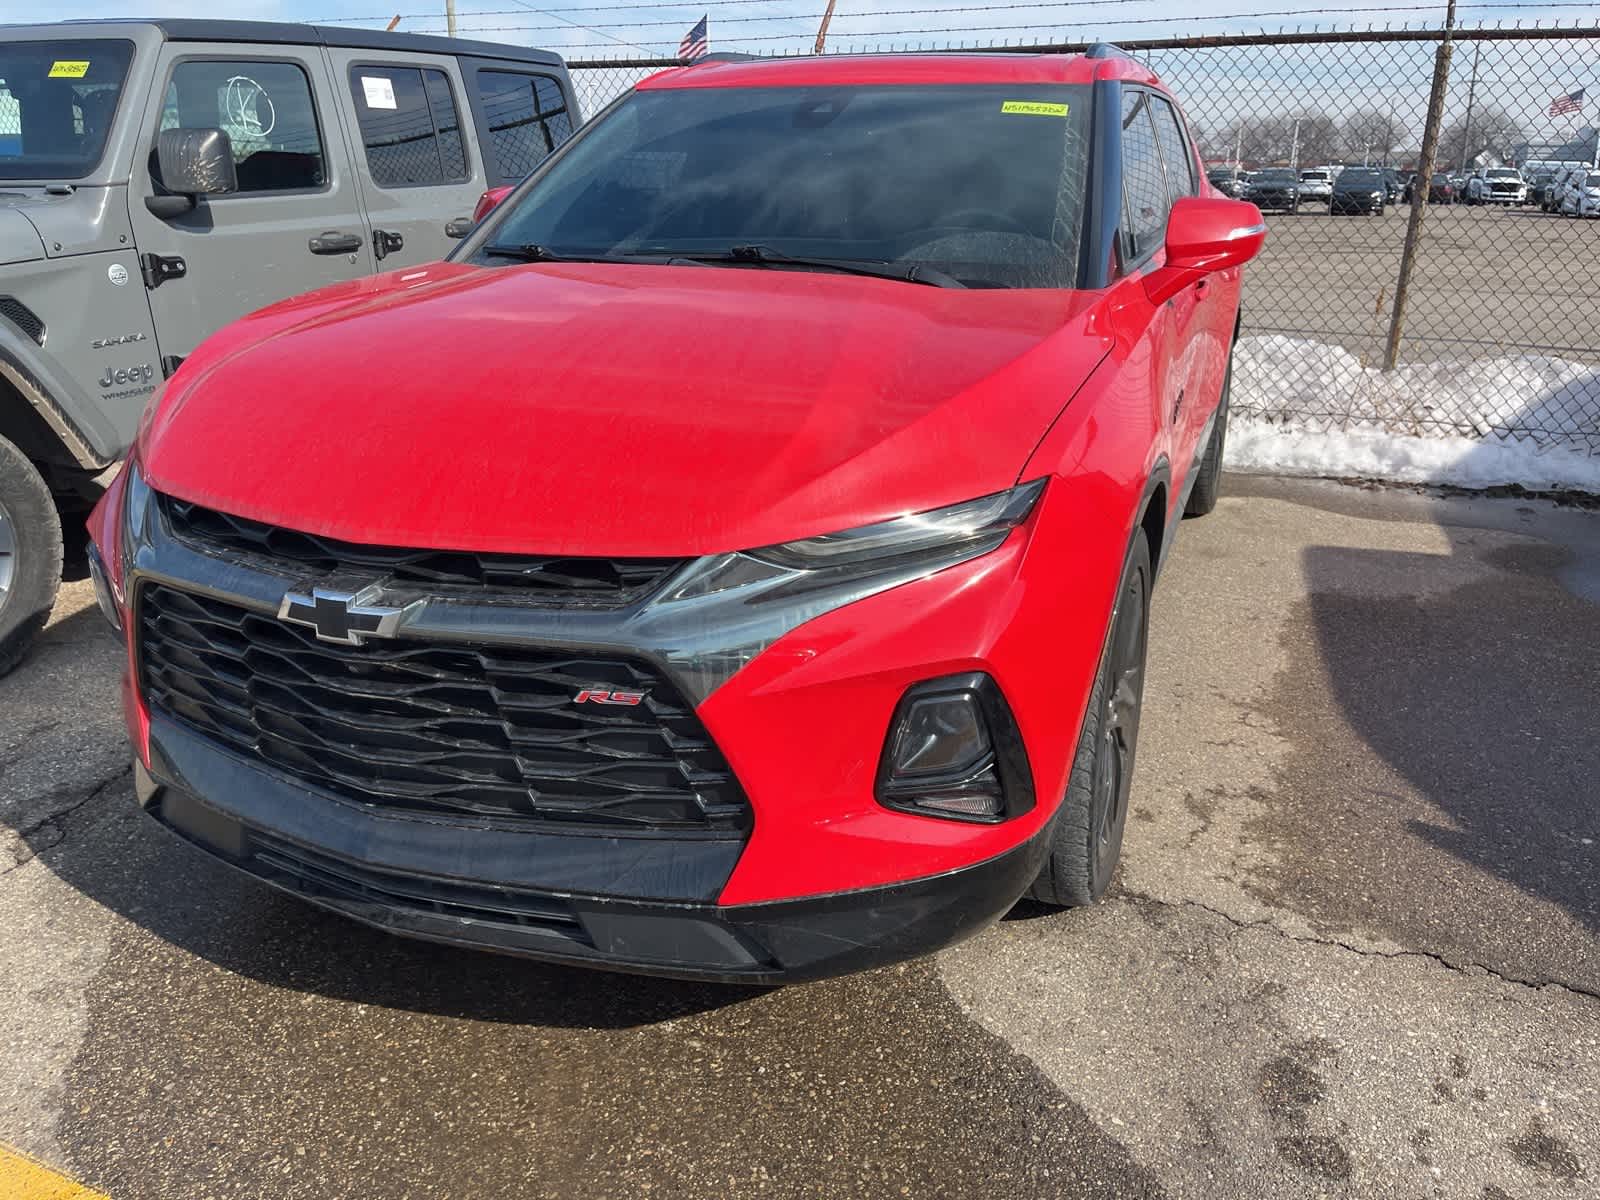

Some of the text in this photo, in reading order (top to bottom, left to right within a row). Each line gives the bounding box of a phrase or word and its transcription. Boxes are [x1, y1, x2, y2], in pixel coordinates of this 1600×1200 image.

[92, 332, 147, 349] SAHARA
[98, 363, 153, 388] Jeep
[573, 690, 645, 706] RS
